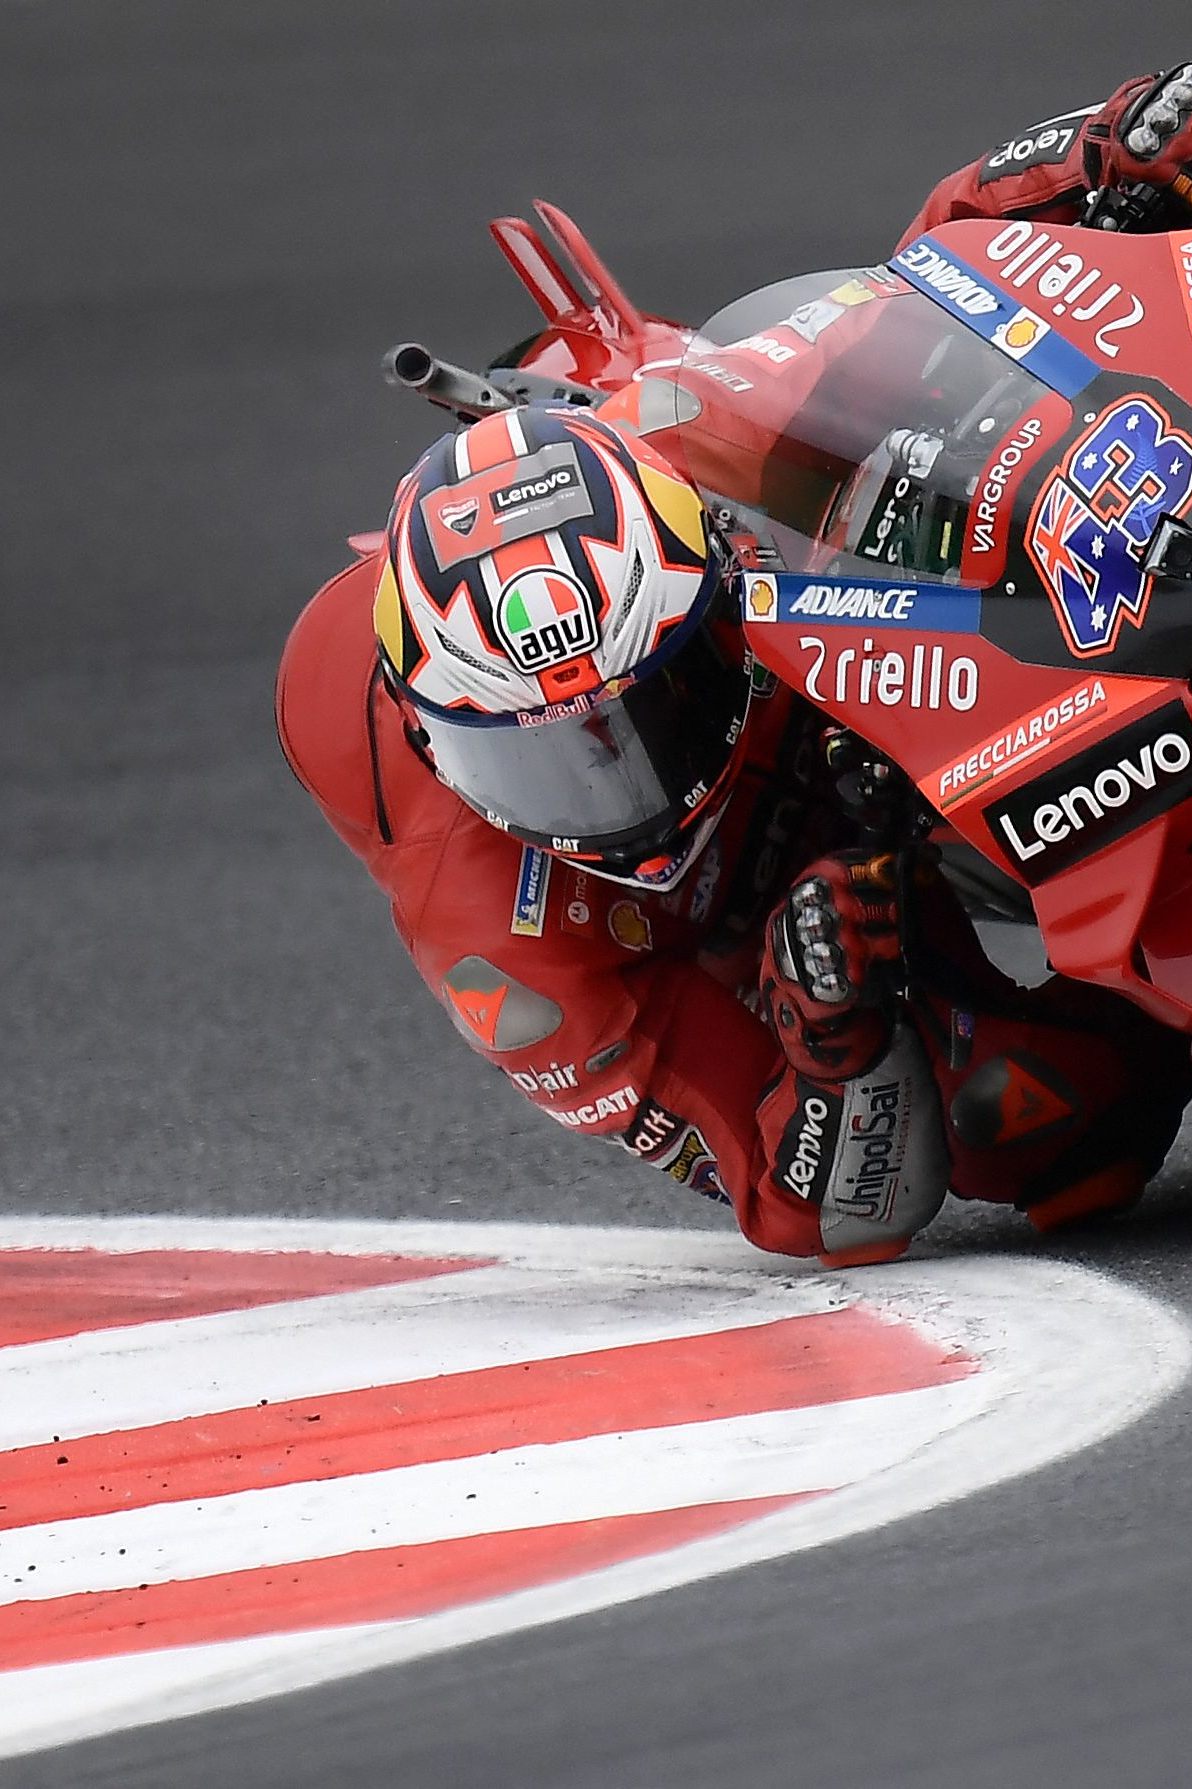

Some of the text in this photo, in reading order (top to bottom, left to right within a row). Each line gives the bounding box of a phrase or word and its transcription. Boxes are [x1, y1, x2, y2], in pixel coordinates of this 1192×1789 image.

[897, 243, 999, 316] ADVANCE
[496, 471, 571, 507] Lenovo
[971, 418, 1042, 553] VARGROUP
[789, 585, 917, 620] ADVANCE
[520, 614, 584, 661] agv
[725, 716, 741, 745] CAT
[939, 681, 1106, 797] FRECCIAROSSA
[684, 780, 708, 808] CAT
[999, 732, 1191, 862] Lenovo
[552, 837, 580, 852] CAT
[835, 1081, 901, 1217] UnipolSai
